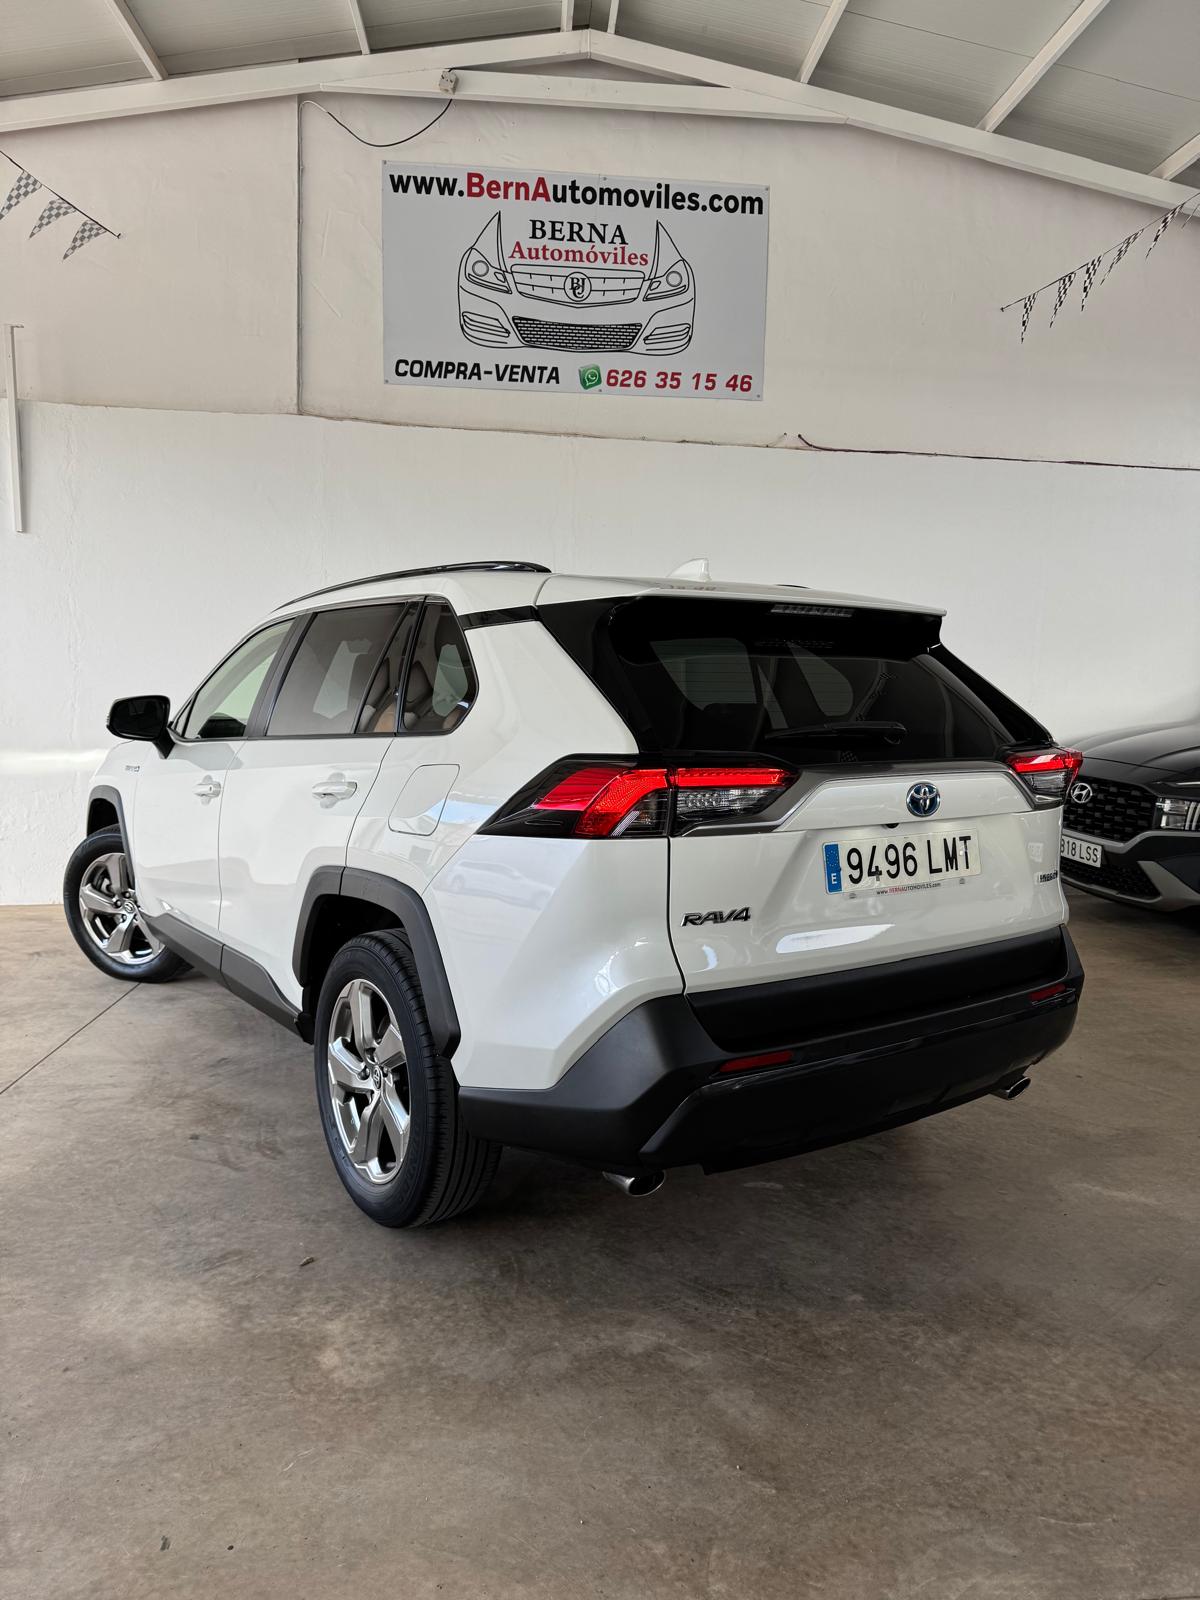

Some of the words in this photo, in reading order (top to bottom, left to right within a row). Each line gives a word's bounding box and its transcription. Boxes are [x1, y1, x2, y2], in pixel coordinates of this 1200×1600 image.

[389, 172, 764, 215] www.BernAutomoviles.com
[529, 219, 629, 245] BERNA
[508, 241, 649, 266] Automóviles
[395, 359, 560, 384] COMPRA-VENTA
[606, 369, 647, 388] 626
[655, 371, 682, 389] 35
[692, 373, 718, 391] 15
[725, 374, 753, 392] 46
[847, 842, 918, 884] 9496
[927, 835, 971, 874] LMT
[1079, 843, 1099, 863] LSS
[831, 873, 838, 884] E
[680, 907, 751, 927] RAV4
